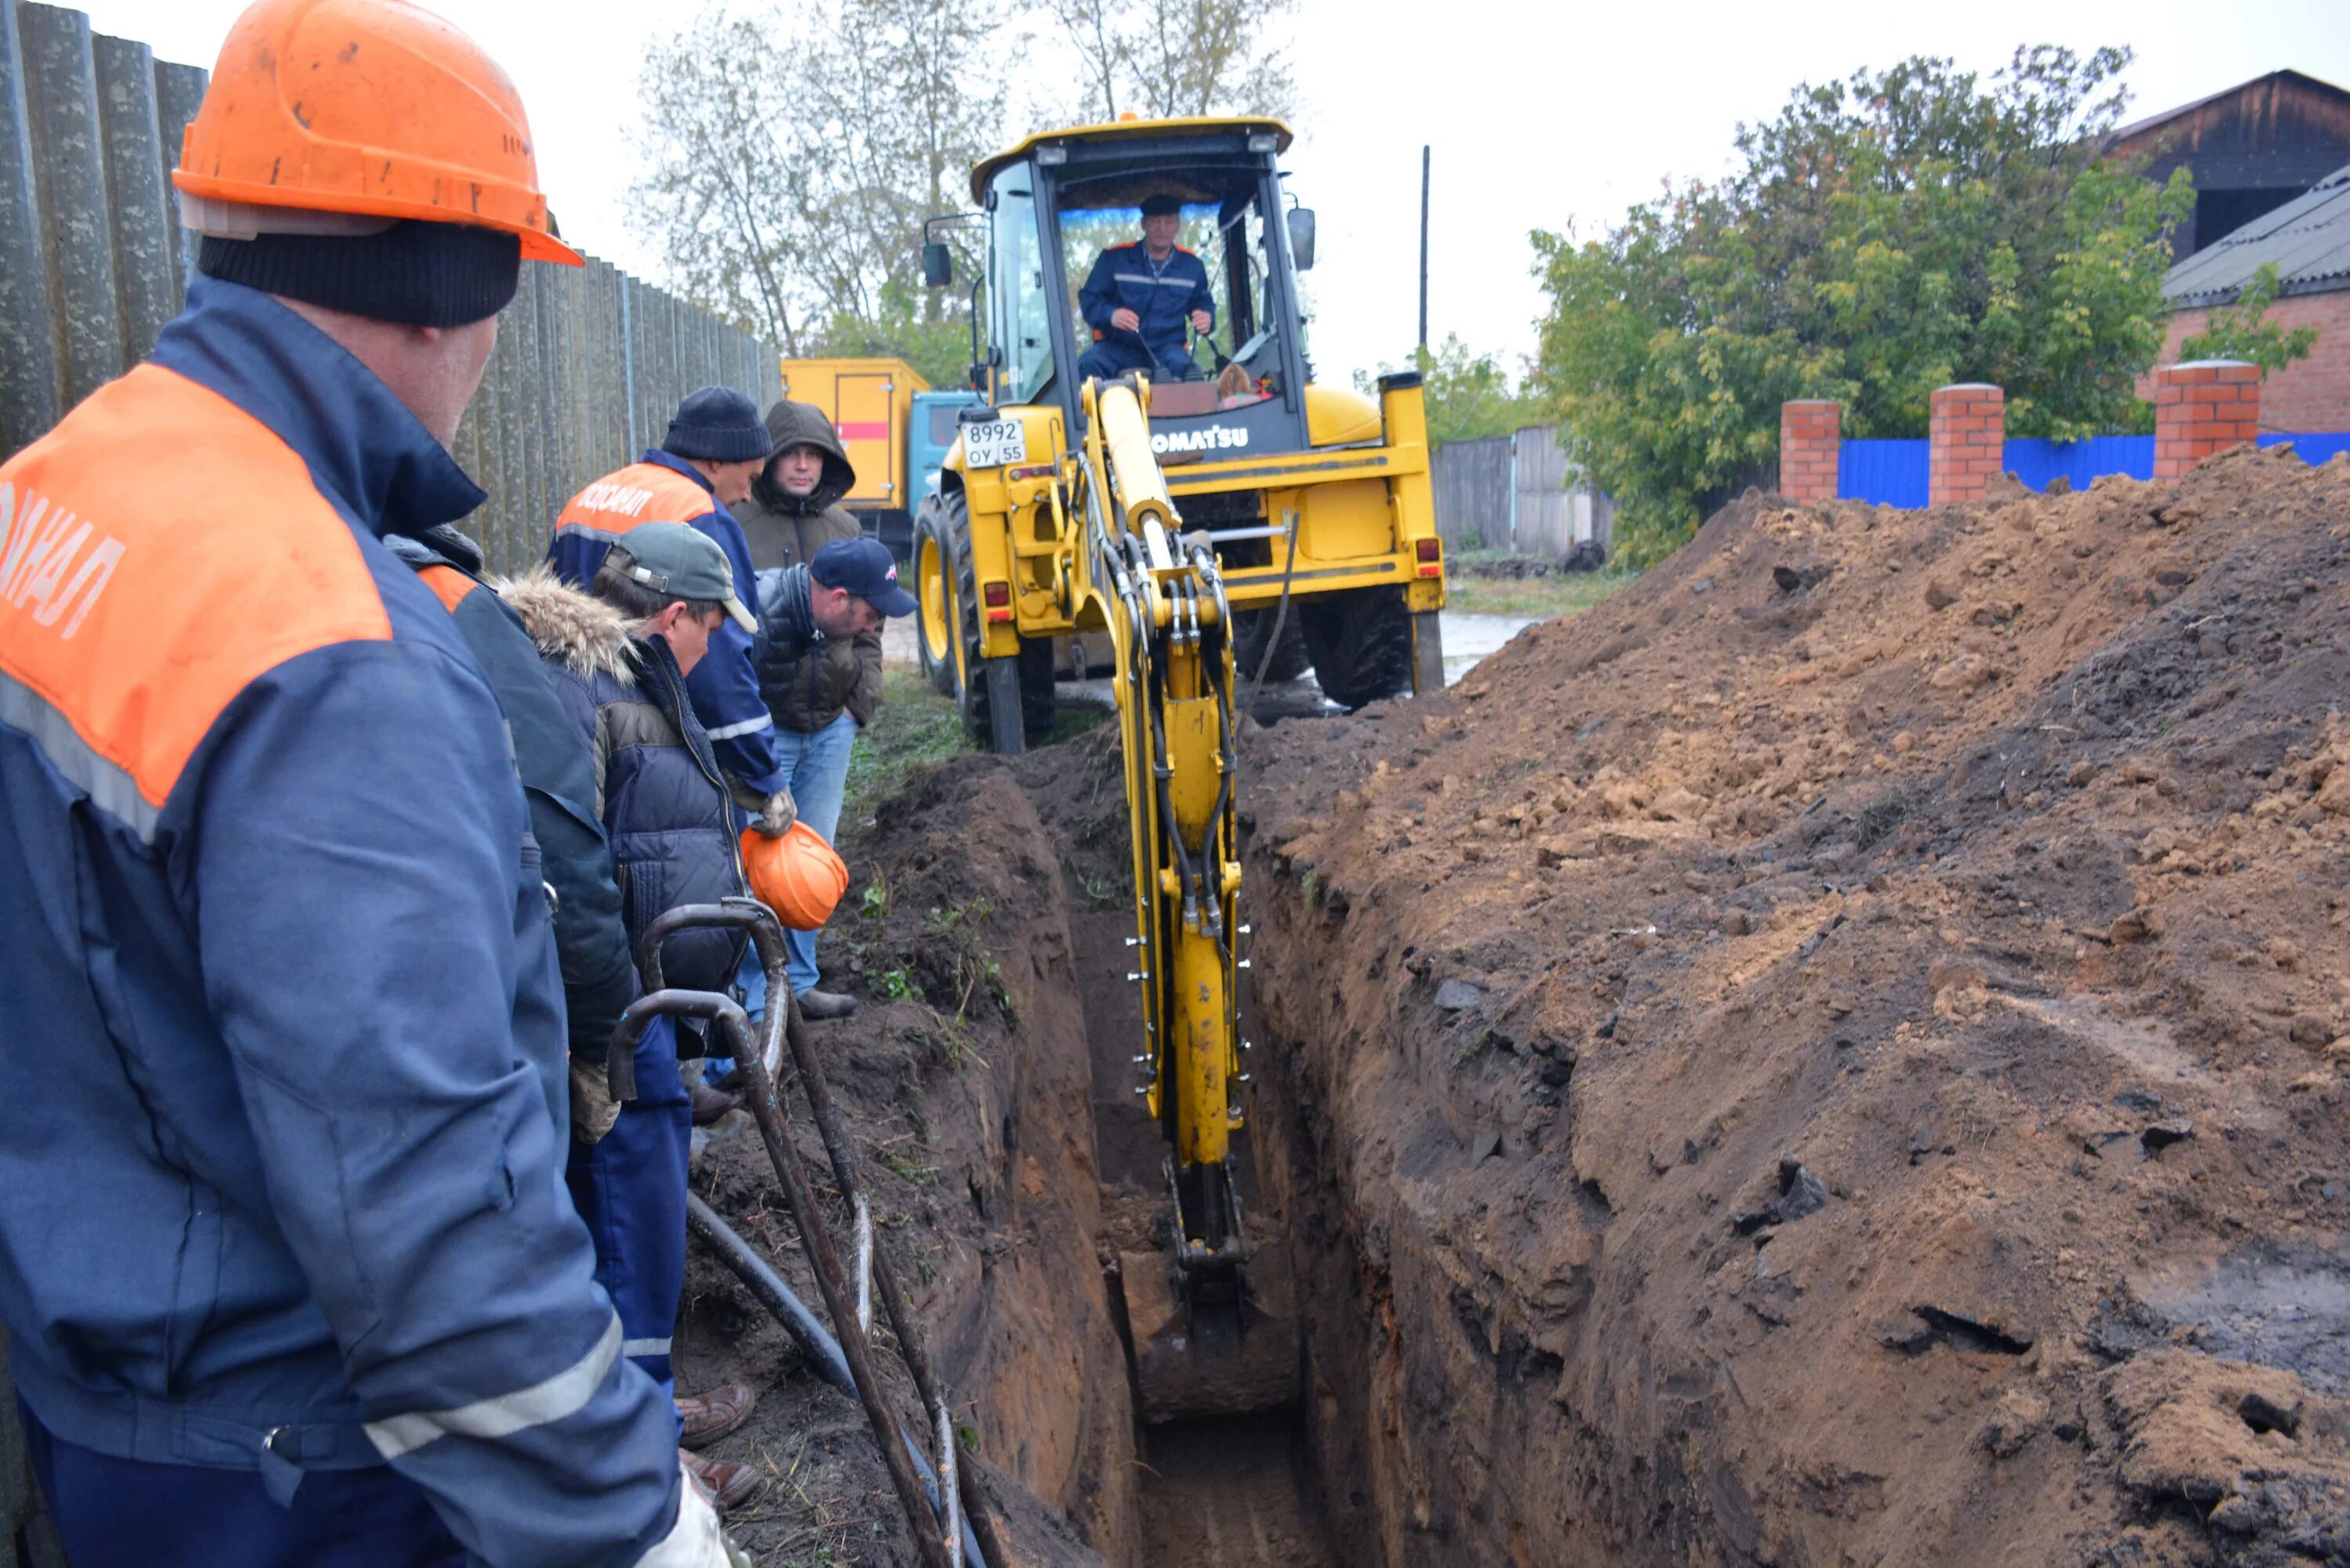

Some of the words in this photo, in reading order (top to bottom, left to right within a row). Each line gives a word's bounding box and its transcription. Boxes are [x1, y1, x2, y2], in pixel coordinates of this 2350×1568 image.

[971, 423, 1016, 443] 8992
[1151, 424, 1249, 453] OMATSU
[1003, 446, 1021, 461] 55
